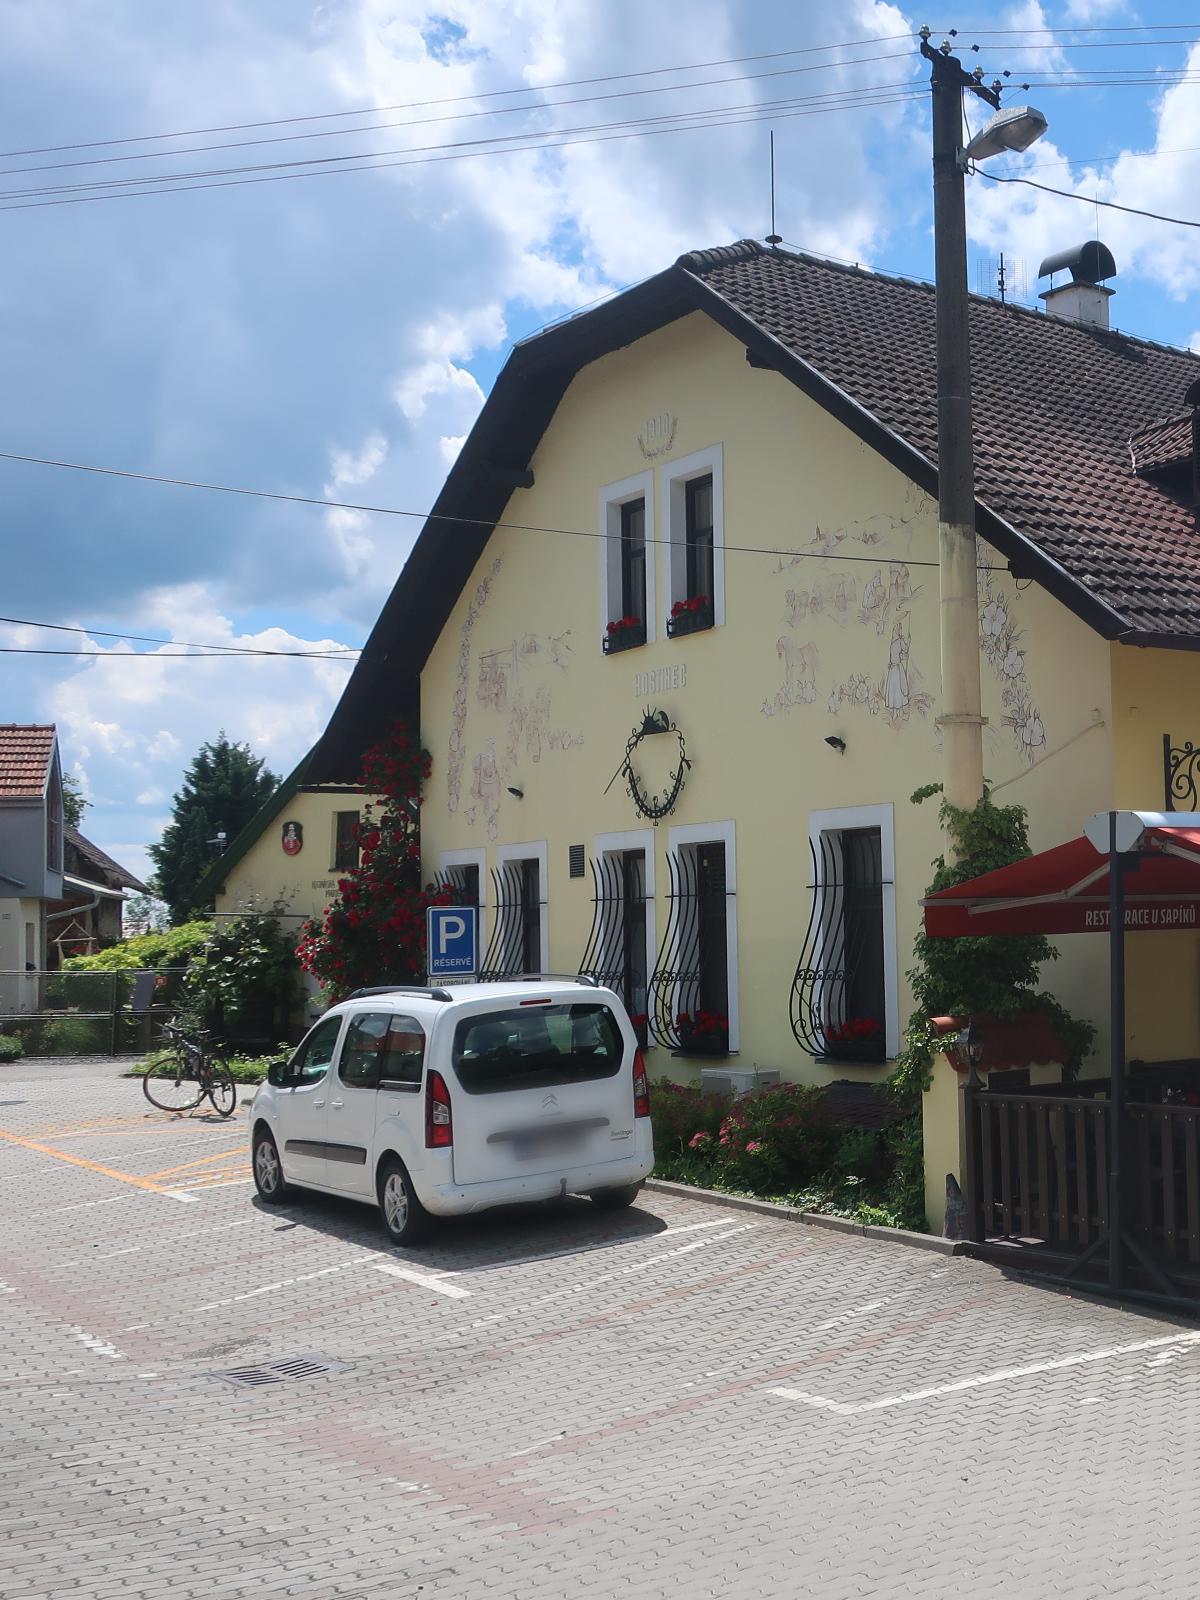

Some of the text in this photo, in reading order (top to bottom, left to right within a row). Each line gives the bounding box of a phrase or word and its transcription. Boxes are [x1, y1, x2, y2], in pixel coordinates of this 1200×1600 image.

[1085, 904, 1196, 926] RESTRACE U SAPÍKŮ
[439, 915, 467, 954] P
